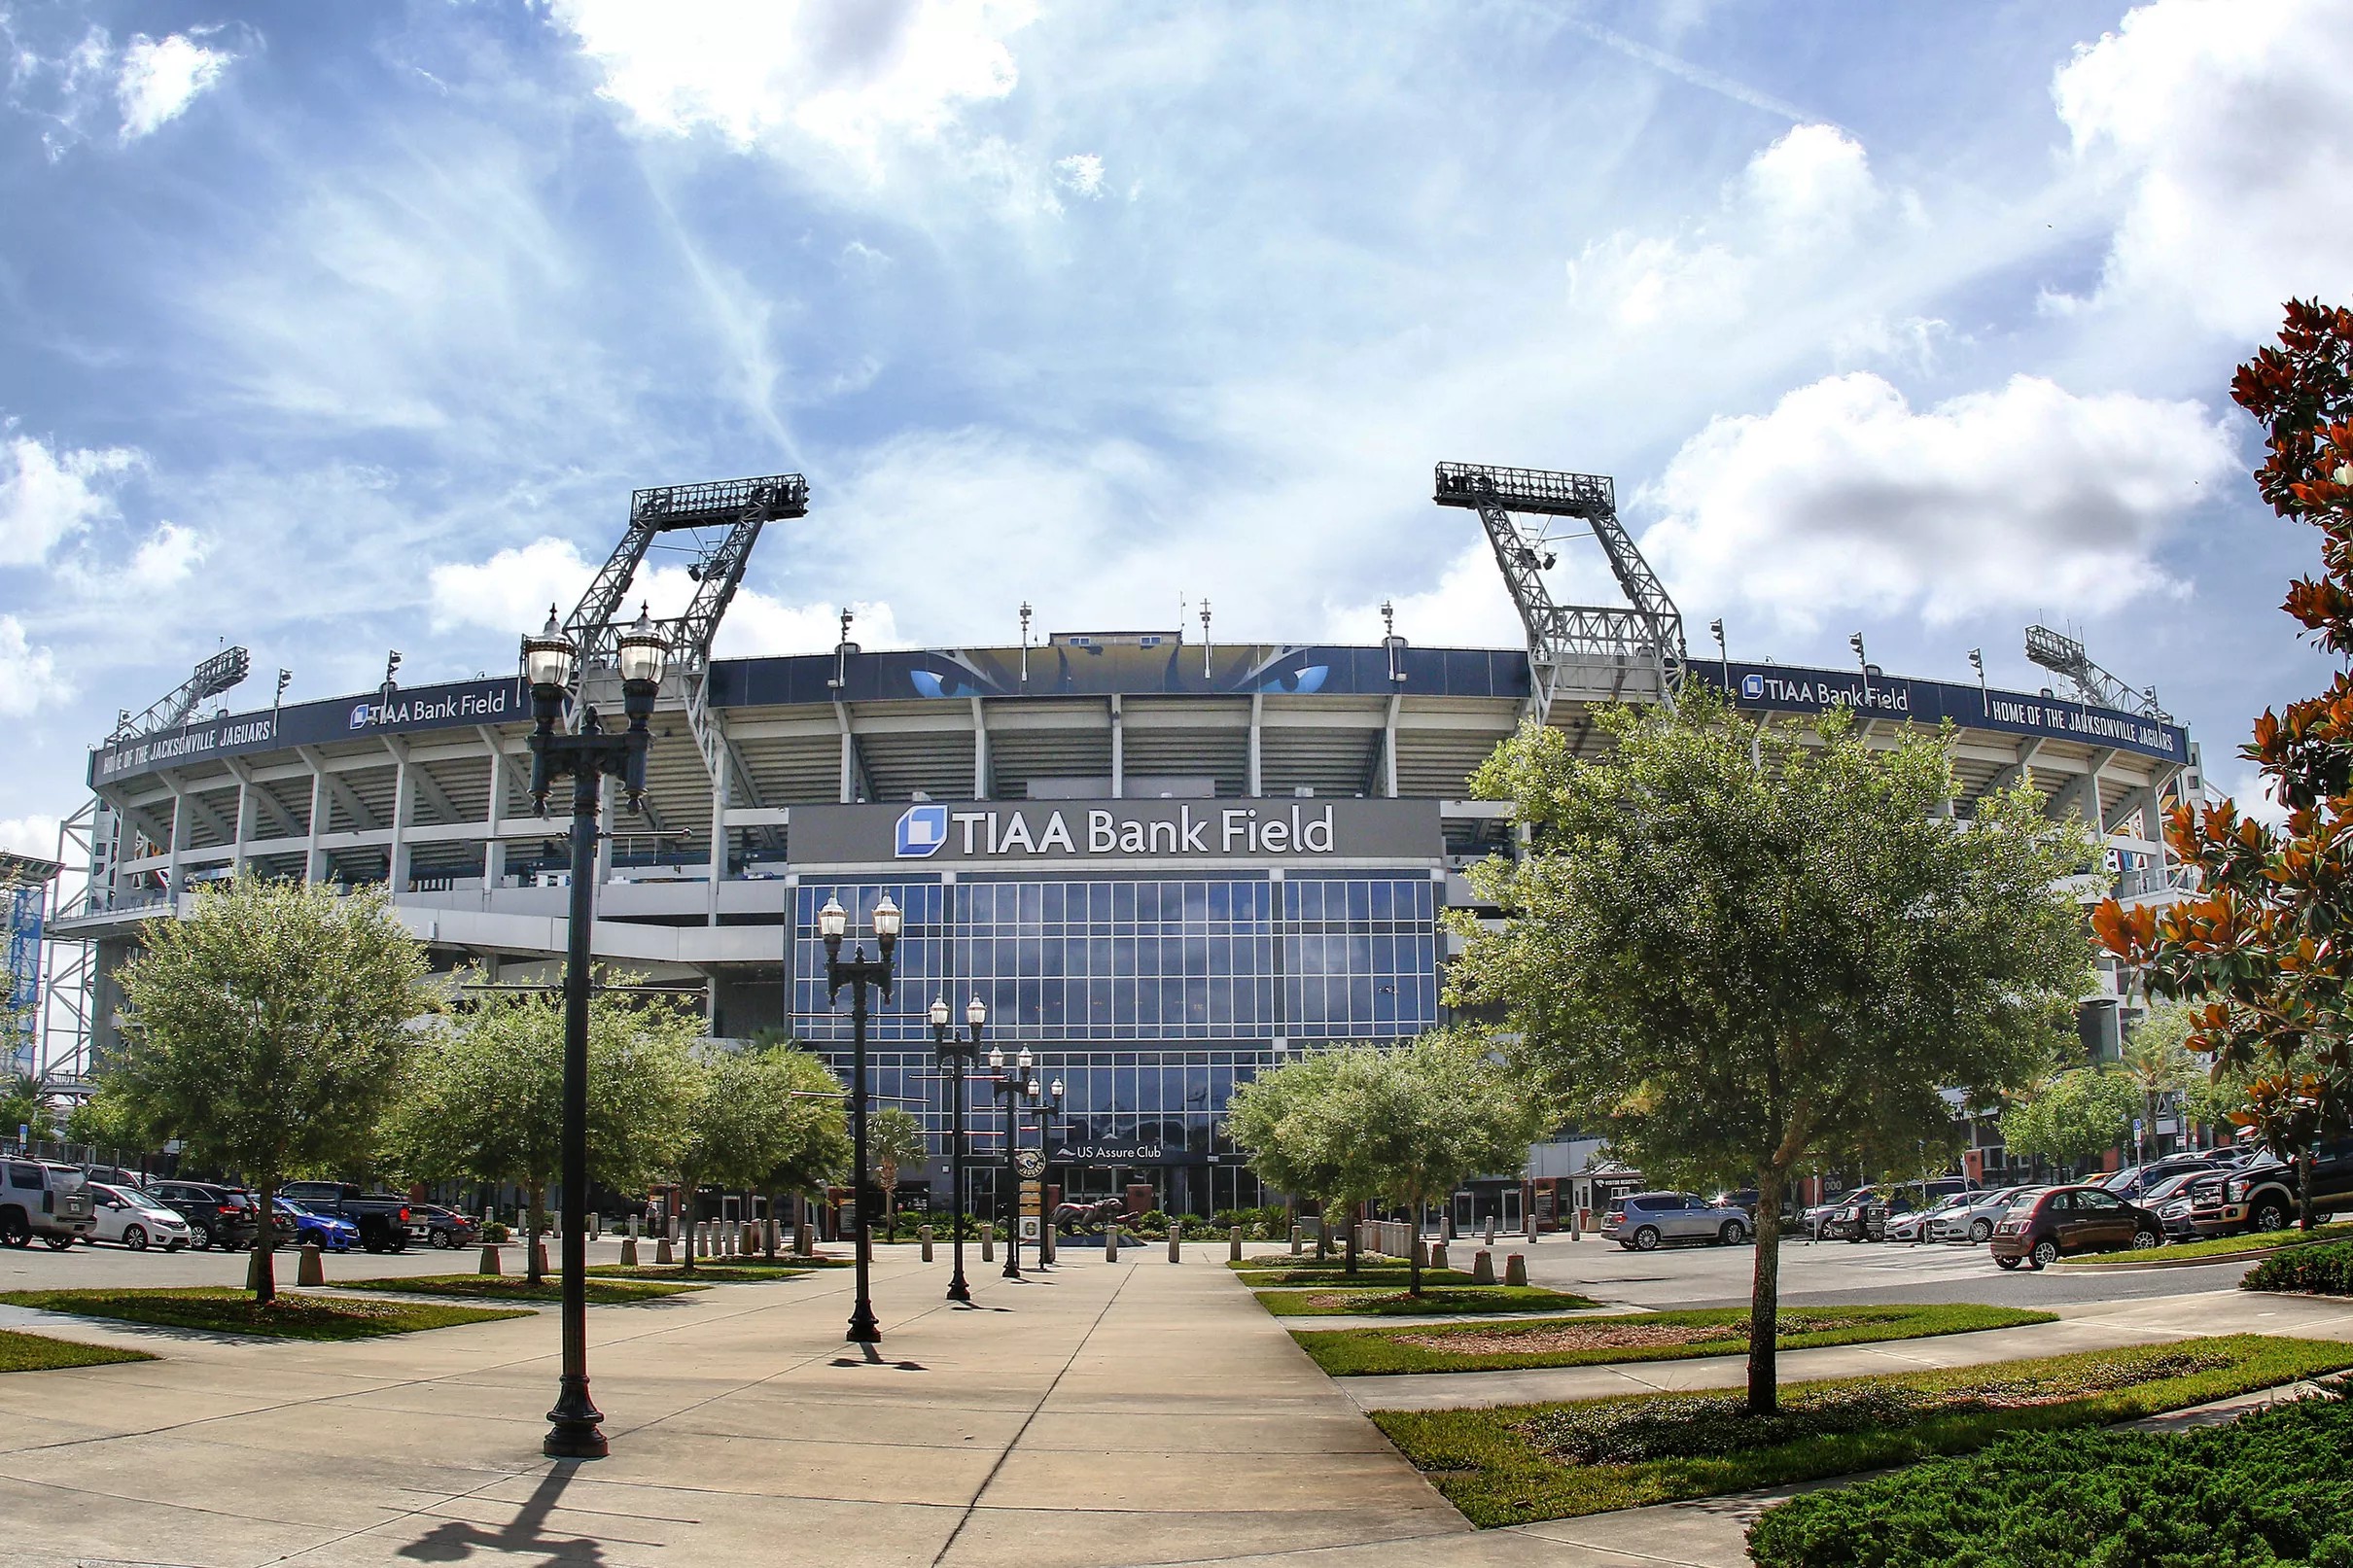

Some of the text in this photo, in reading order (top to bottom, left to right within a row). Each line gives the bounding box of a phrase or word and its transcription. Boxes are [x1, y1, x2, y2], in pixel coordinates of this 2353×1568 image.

[369, 689, 506, 725] TIAA Bank Field
[1765, 679, 1910, 712] TIAA Bank Field
[123, 749, 134, 768] OF
[135, 744, 150, 766] THE
[150, 729, 216, 762] JACKSONVILLE
[219, 720, 271, 748] JAGUARS
[1992, 700, 2174, 753] HOME OF THE JACKSONVILLE JAGUARS
[951, 804, 1335, 854] TIAA Bank Field
[1020, 1161, 1044, 1175] JAGUARS
[1076, 1145, 1162, 1159] US Assure Club
